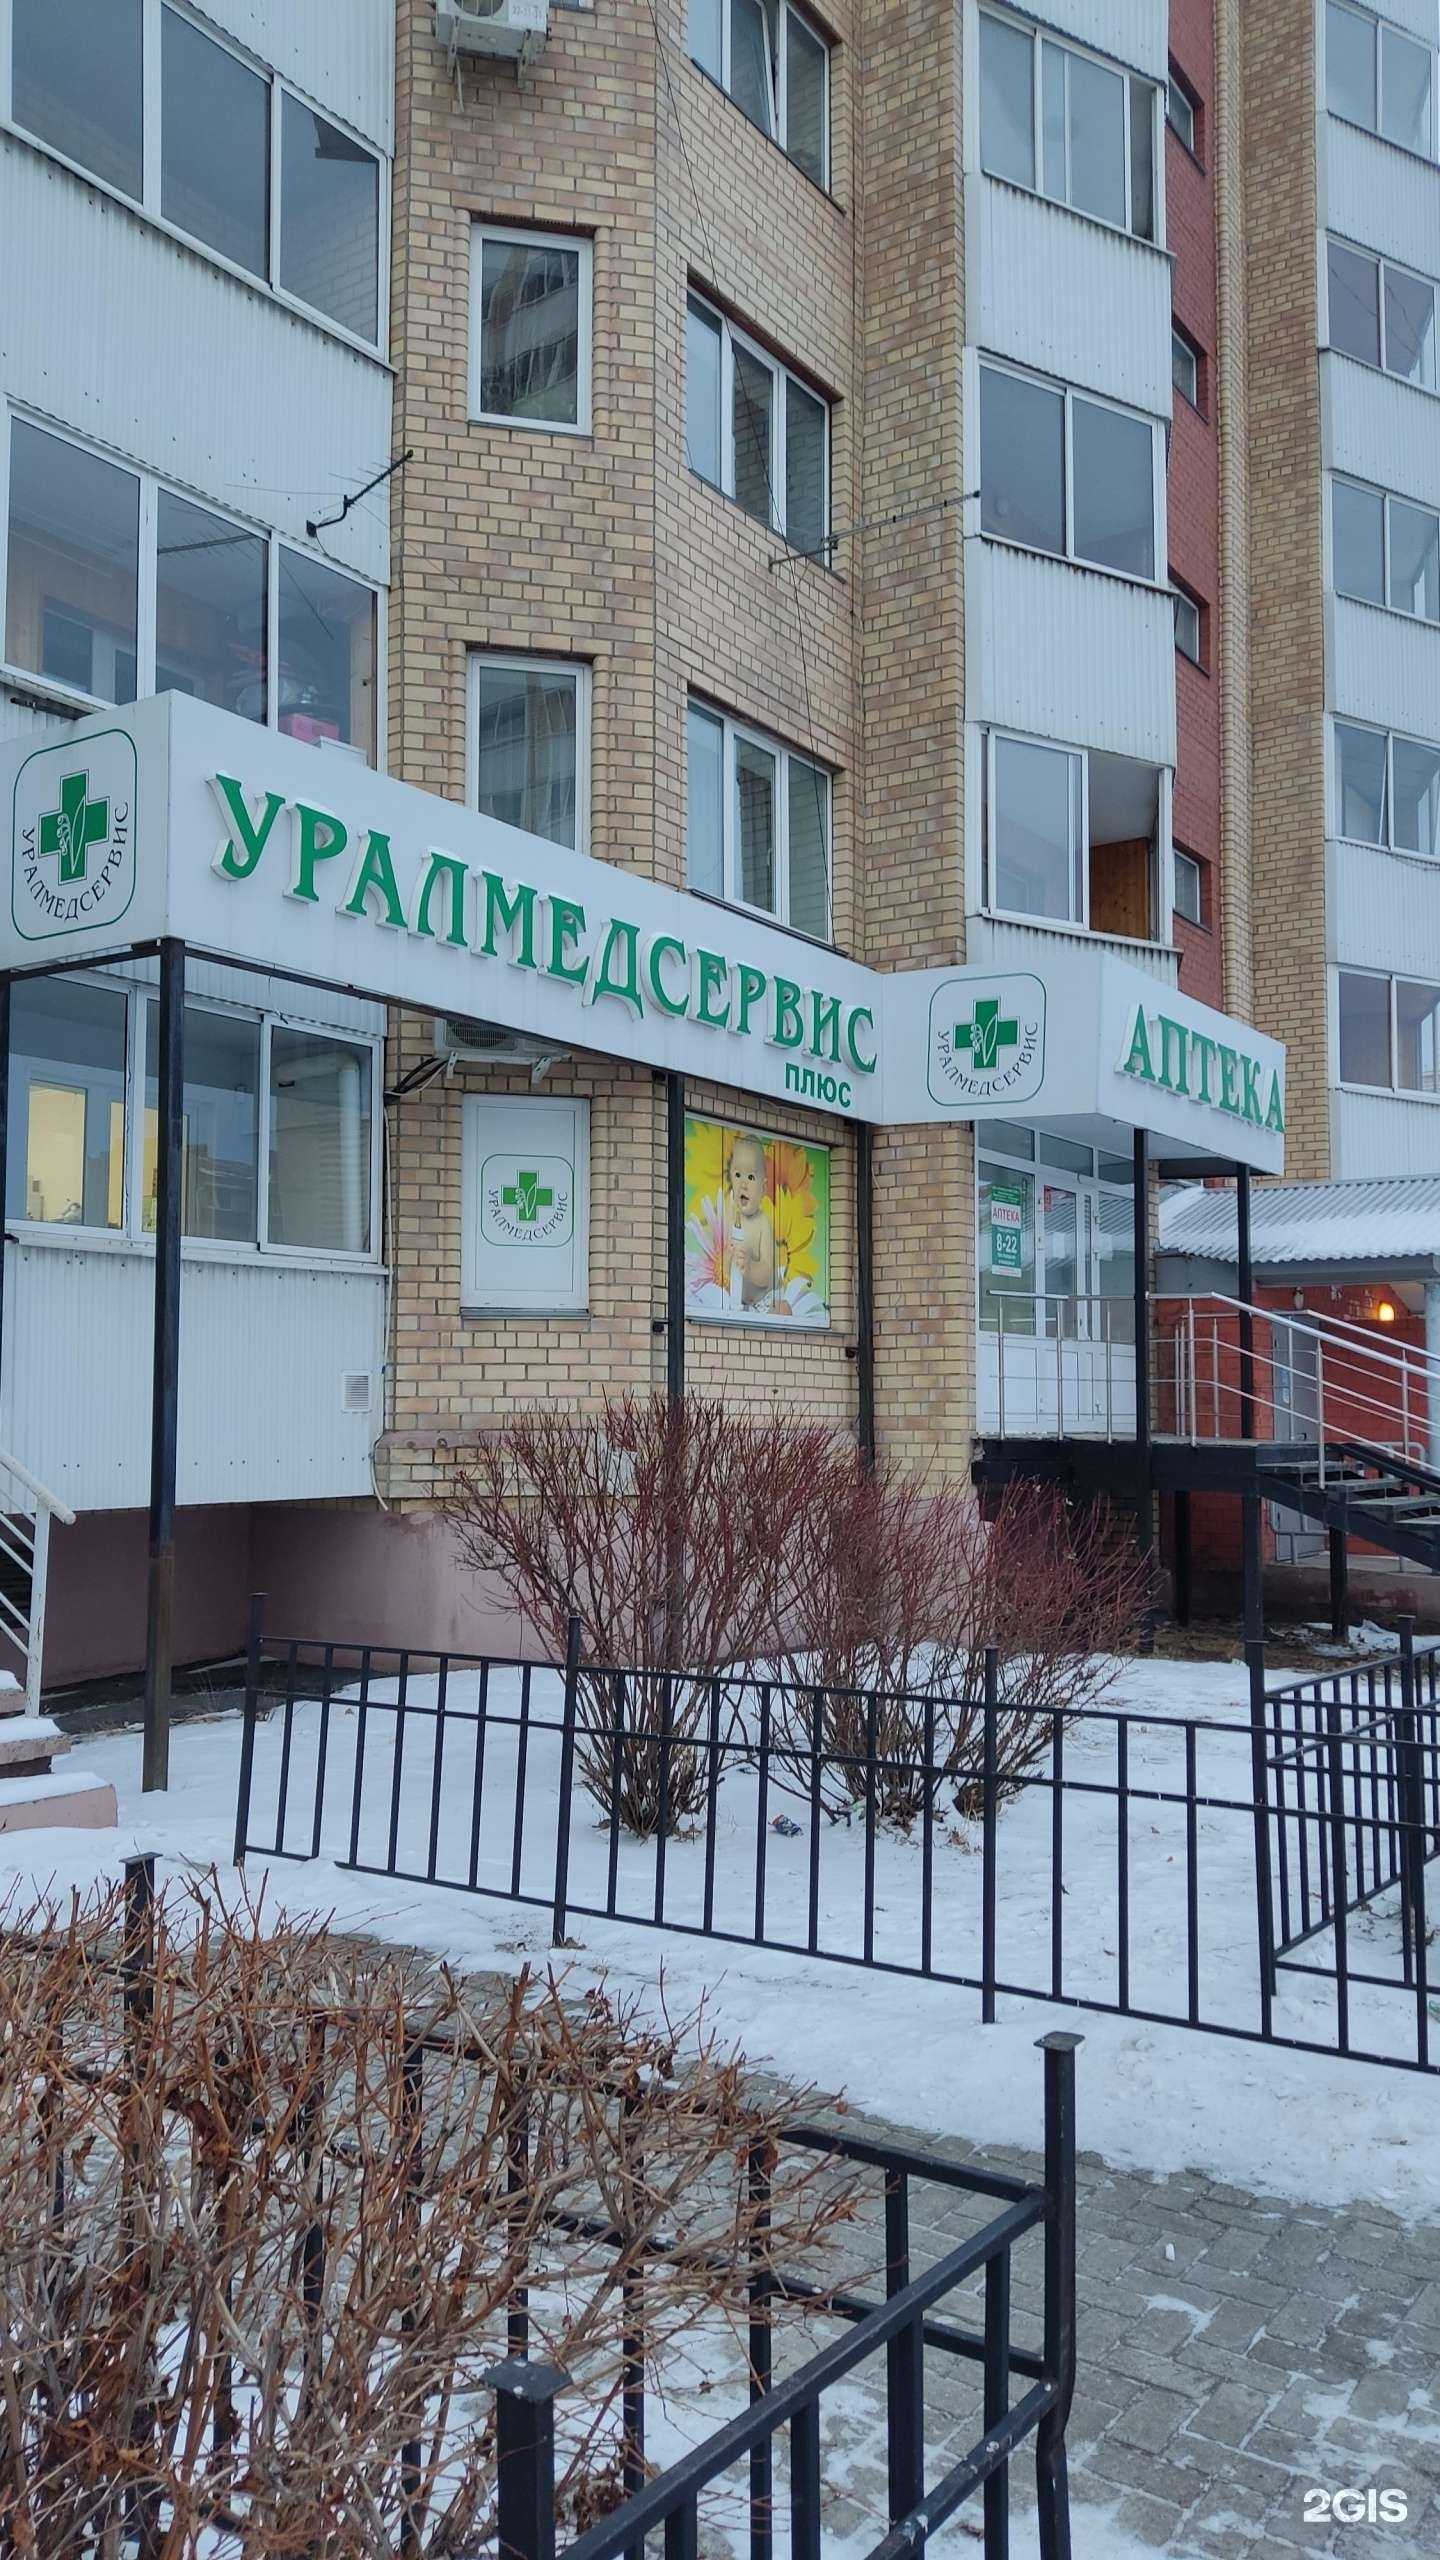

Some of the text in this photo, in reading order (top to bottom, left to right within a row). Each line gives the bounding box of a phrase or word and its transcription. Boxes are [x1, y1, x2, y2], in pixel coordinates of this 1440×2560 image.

[20, 800, 129, 921] УРАЛМЕДСЕРВИС
[208, 771, 878, 1074] УРАЛМЕДСЕРВИС
[936, 1021, 1039, 1096] УРАЛМЕДСЕРВИС
[1117, 1003, 1286, 1133] АПТЕКА
[992, 1207, 1020, 1225] АПТЕКА
[996, 1233, 1018, 1254] 8-22
